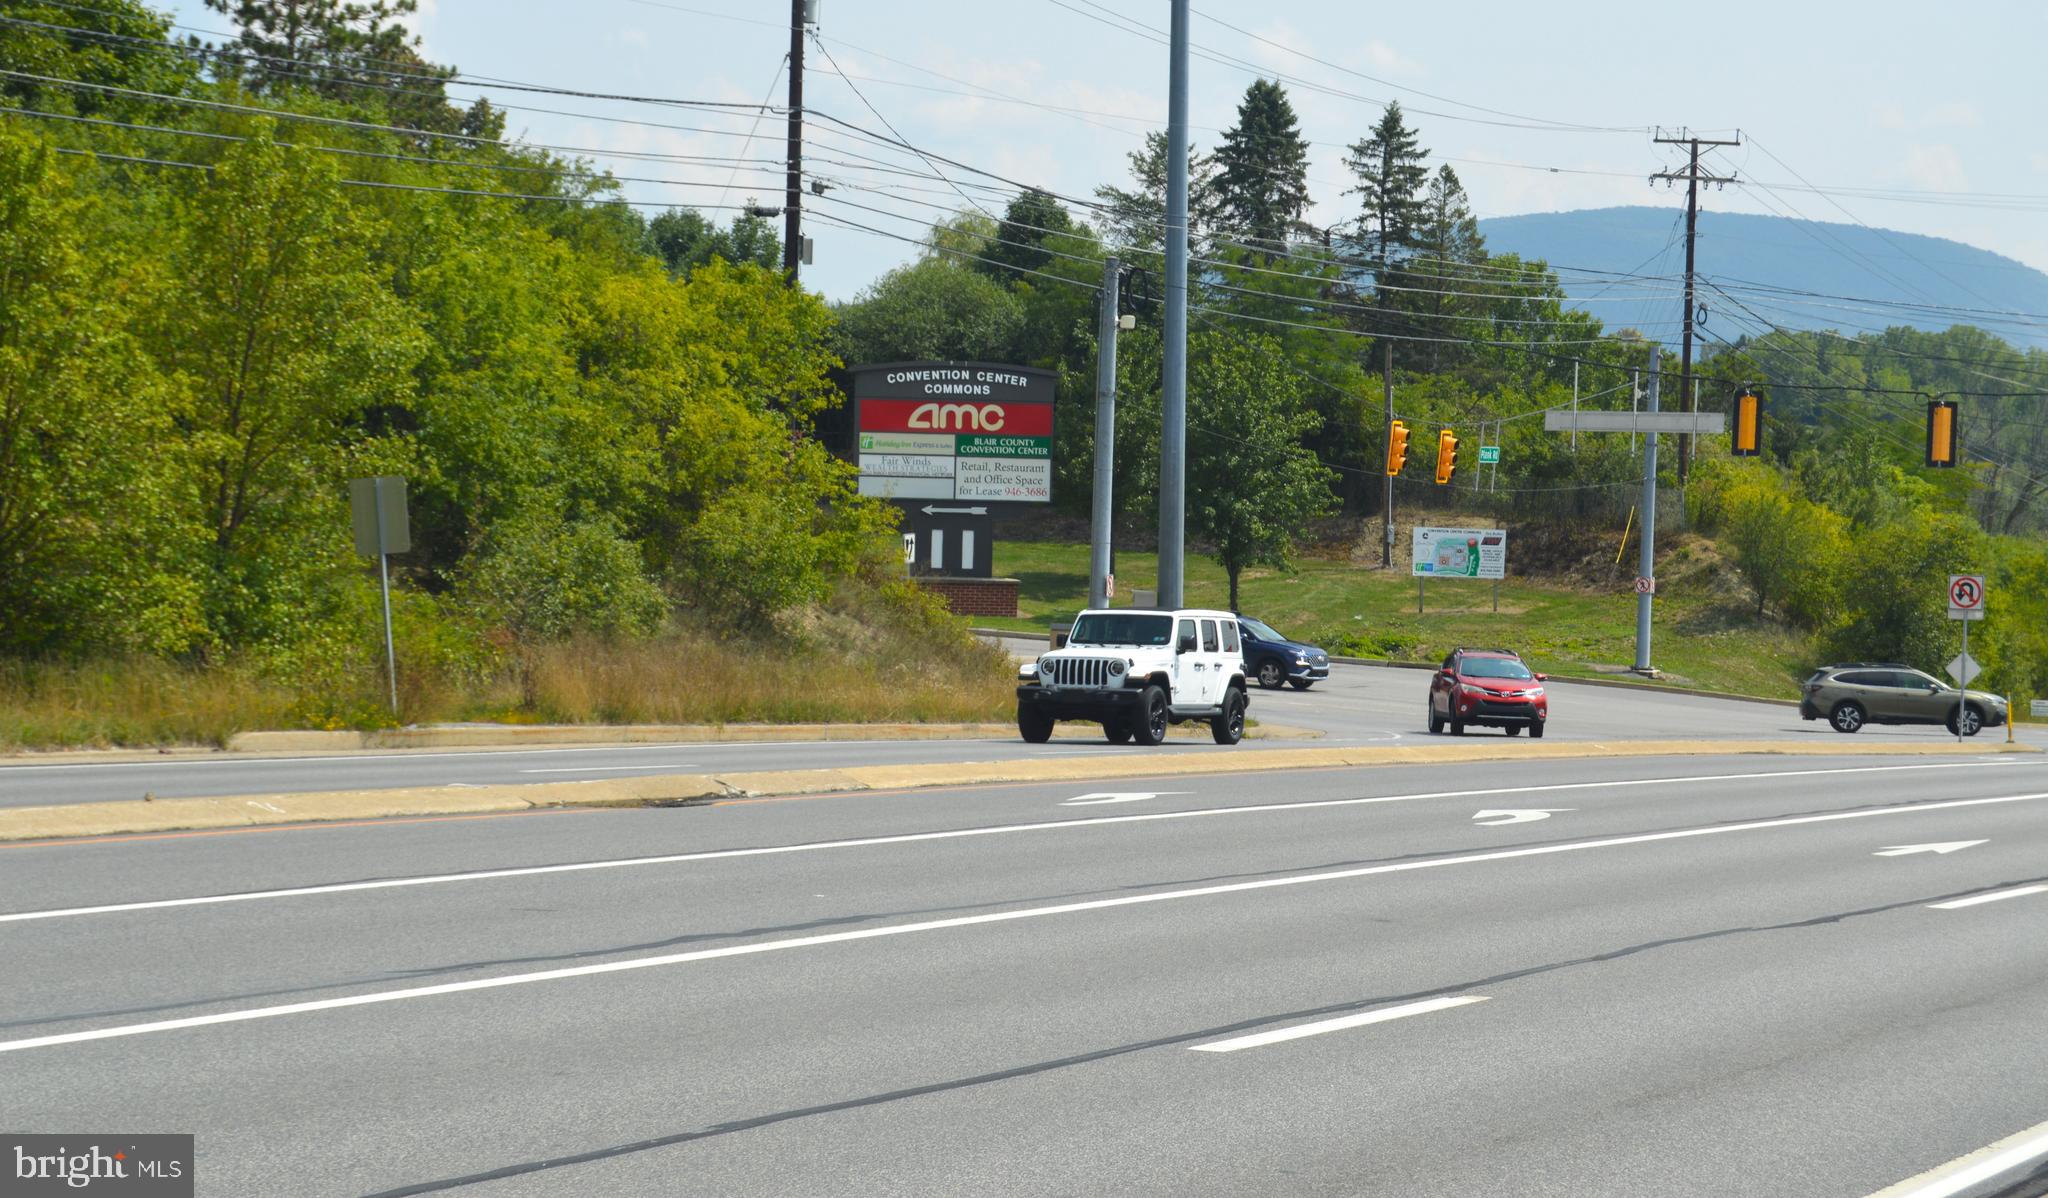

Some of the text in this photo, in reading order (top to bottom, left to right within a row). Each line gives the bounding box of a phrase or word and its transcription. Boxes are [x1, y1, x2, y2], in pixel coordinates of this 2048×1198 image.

[887, 370, 1028, 387] CONVENTION CENTER
[924, 384, 990, 395] COMMONS
[974, 437, 1035, 447] BLAIR COUNTY
[960, 445, 1048, 455] CONVENTION CENTER
[881, 456, 931, 465] Fair Winds
[961, 461, 1044, 473] Retail, Restaurant
[963, 474, 981, 484] and
[984, 475, 1012, 484] Office
[1015, 475, 1043, 487] Space
[960, 485, 1048, 497] for Lease 946-3686
